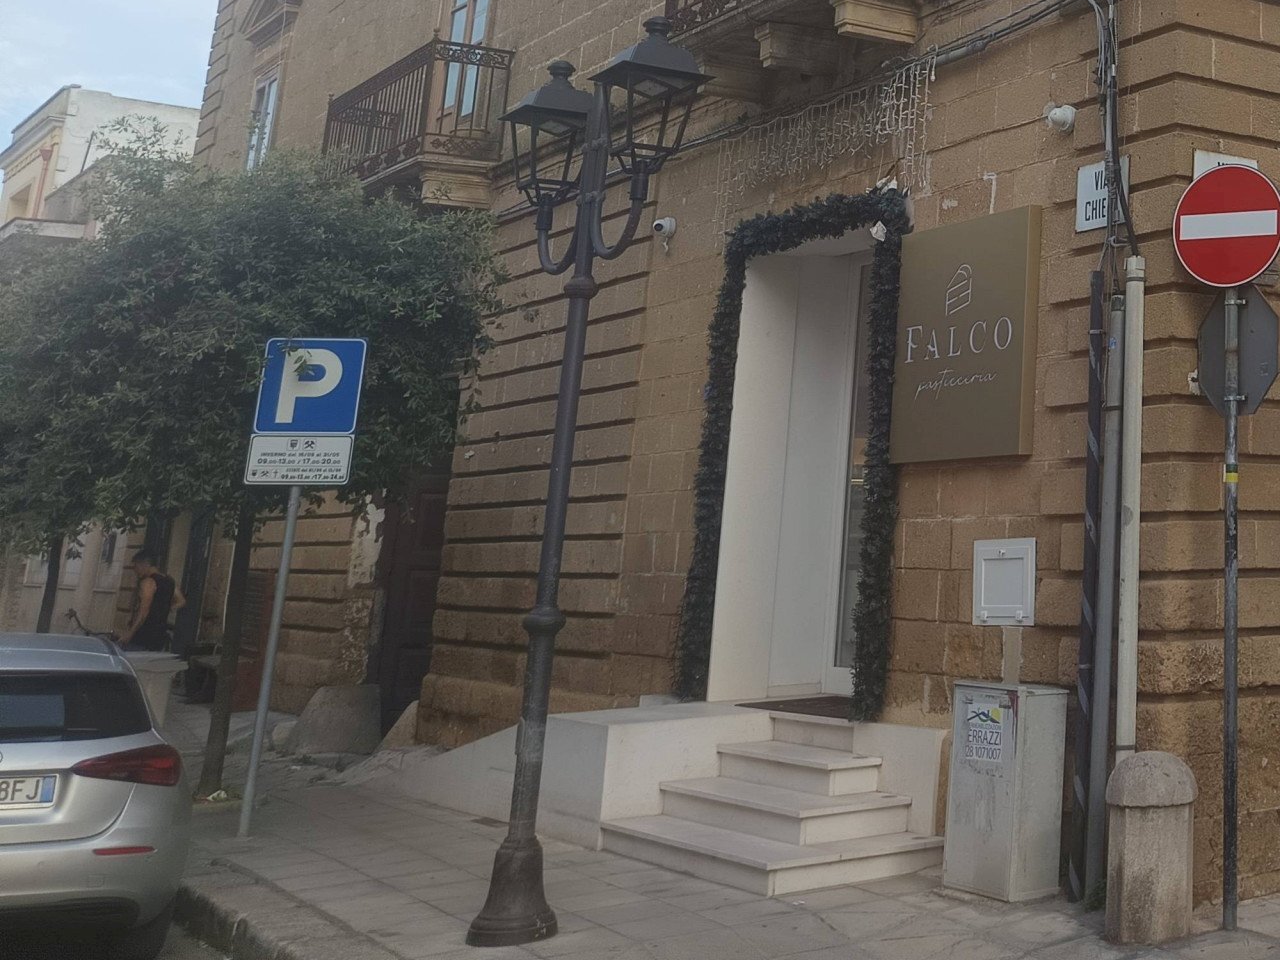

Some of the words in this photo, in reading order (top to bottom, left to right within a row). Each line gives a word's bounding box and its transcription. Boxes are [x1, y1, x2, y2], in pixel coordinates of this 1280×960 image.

[1084, 197, 1107, 222] CHIE
[904, 316, 1012, 364] FALCO
[275, 348, 343, 424] P
[914, 368, 998, 401] pasticceria
